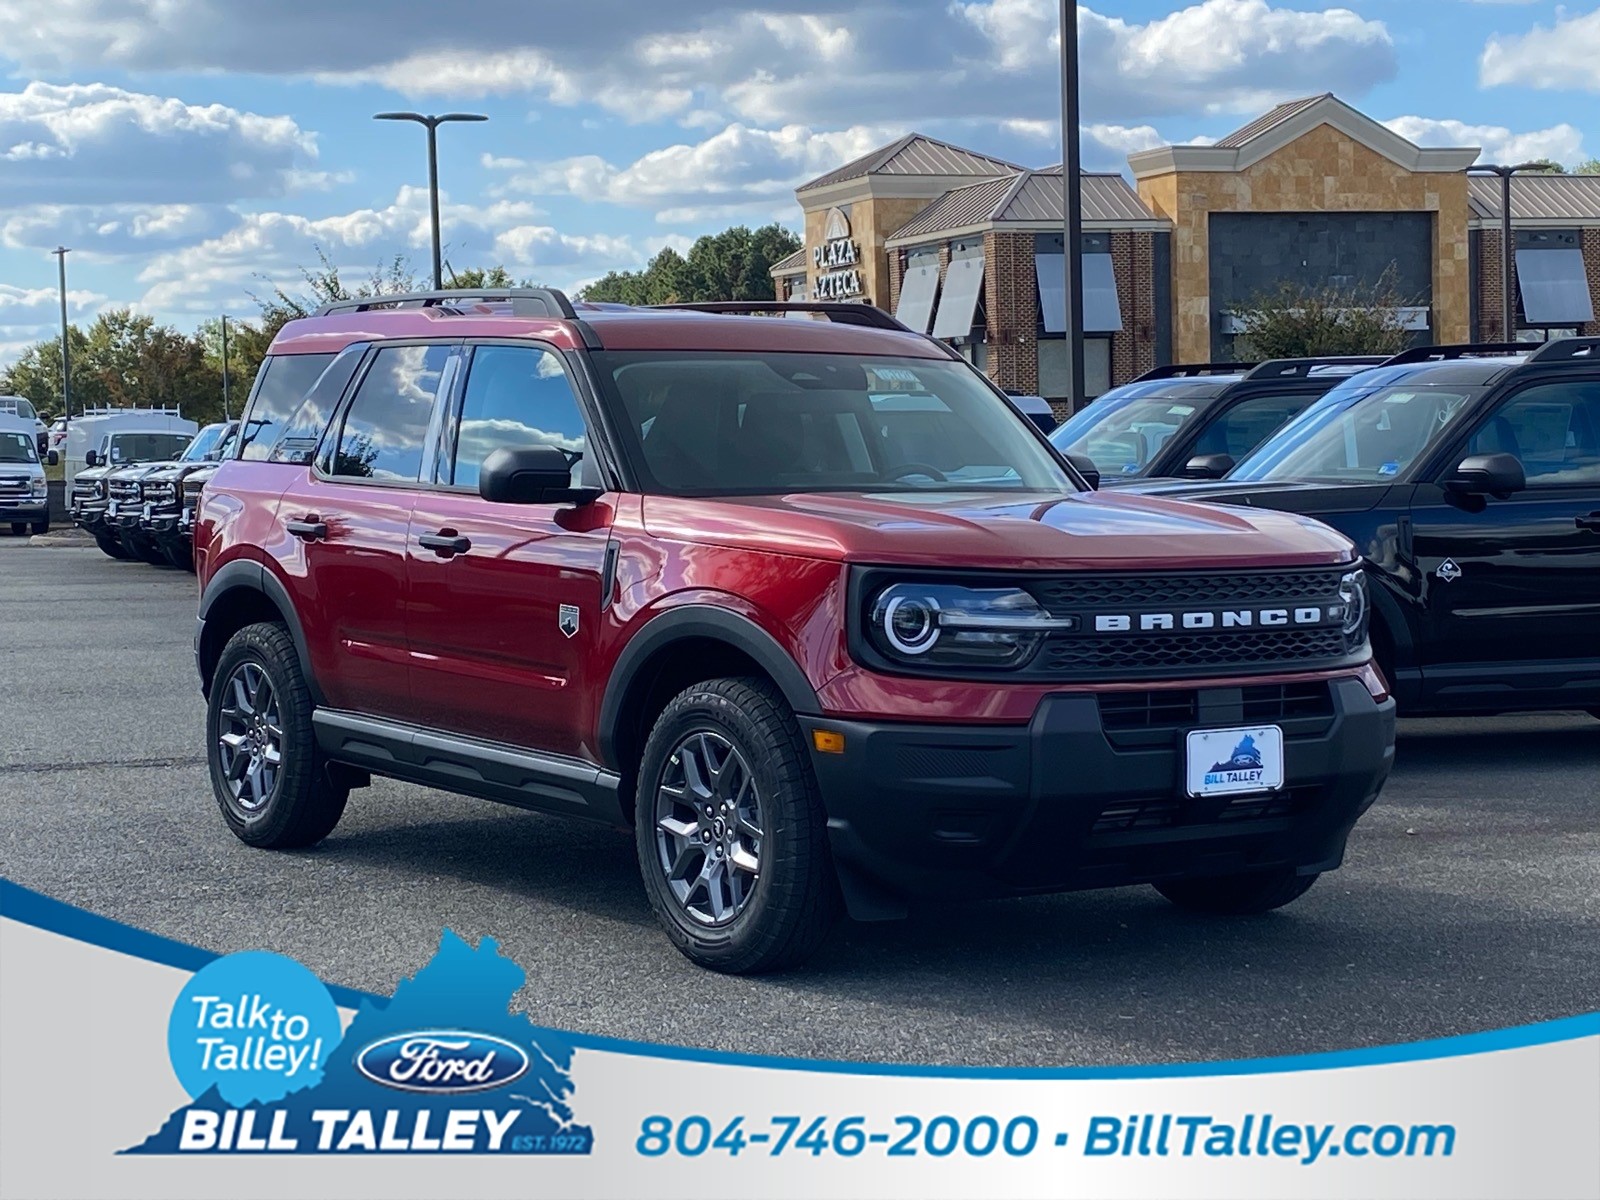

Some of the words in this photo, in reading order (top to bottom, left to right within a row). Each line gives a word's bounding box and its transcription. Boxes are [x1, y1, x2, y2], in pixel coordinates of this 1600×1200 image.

[813, 240, 856, 267] PLAZA
[812, 270, 861, 298] AZTECA
[1095, 607, 1321, 631] BRONCO
[1204, 774, 1225, 785] BILL
[1226, 769, 1263, 783] TALLEY
